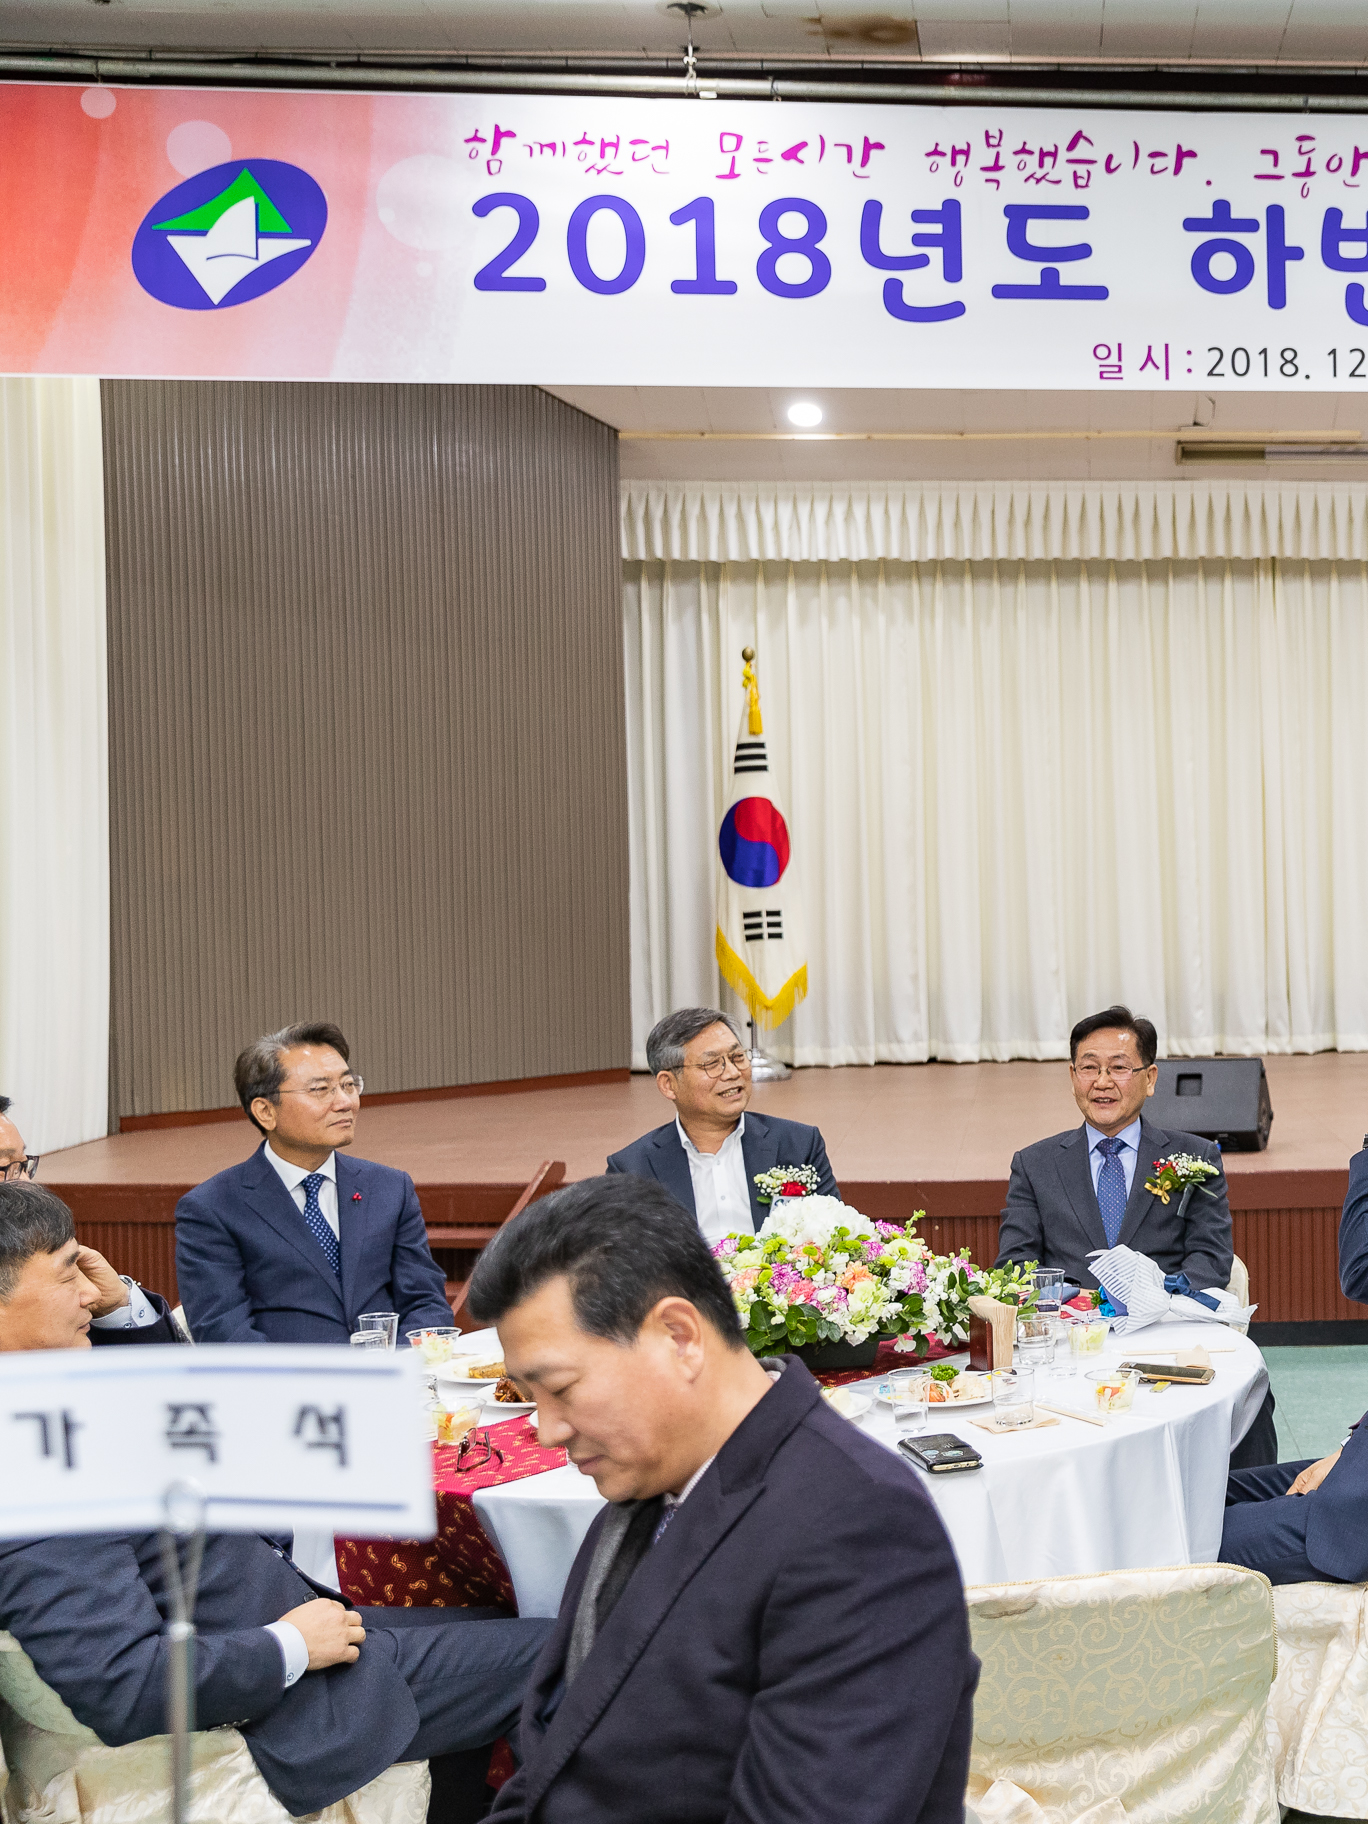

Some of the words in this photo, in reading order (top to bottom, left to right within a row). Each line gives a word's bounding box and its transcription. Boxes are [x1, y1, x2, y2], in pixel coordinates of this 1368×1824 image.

[463, 123, 671, 177] 함께했던
[715, 131, 887, 181] 모든시간
[924, 128, 1214, 191] 행복했습니다.
[471, 191, 1111, 324] 2018년도
[1206, 346, 1311, 380] 2018.
